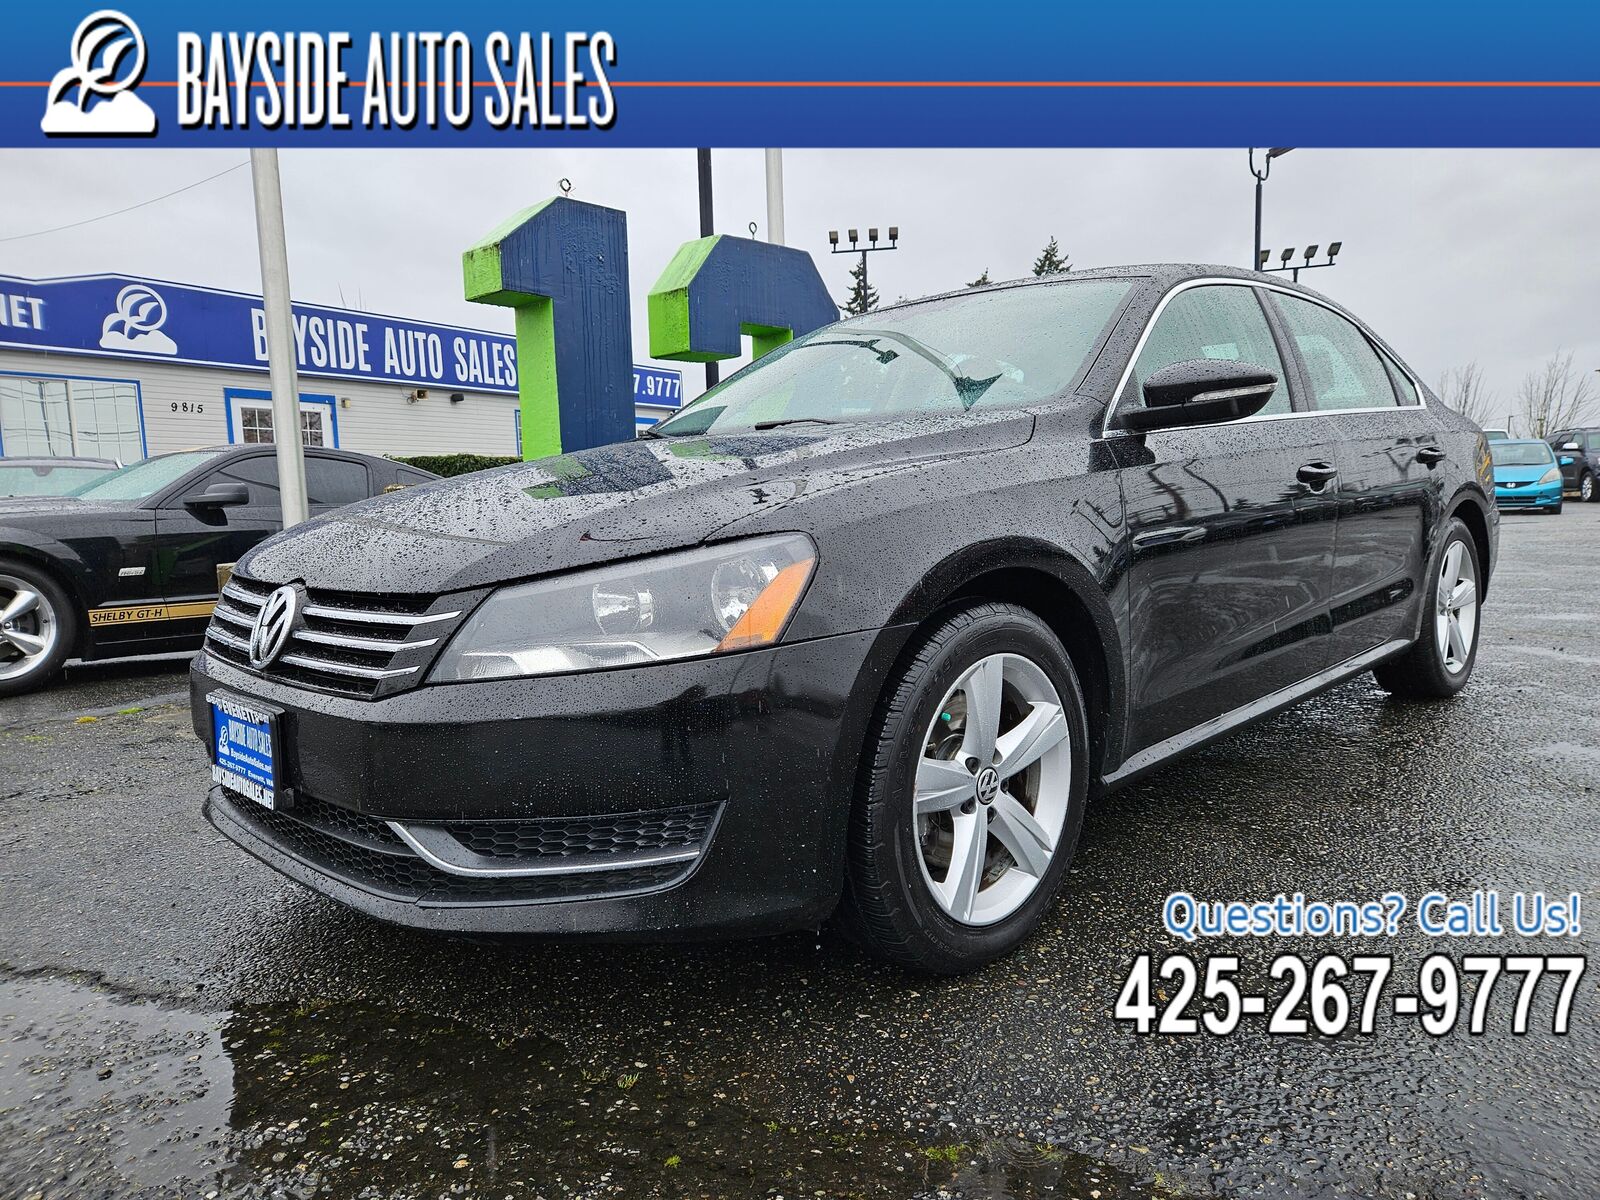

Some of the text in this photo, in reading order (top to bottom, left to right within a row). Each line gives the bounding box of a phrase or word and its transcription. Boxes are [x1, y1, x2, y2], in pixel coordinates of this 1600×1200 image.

[251, 308, 517, 387] BYSIDE AUTO SALES
[171, 402, 204, 414] 9815
[92, 609, 162, 622] SHELBY GT-H
